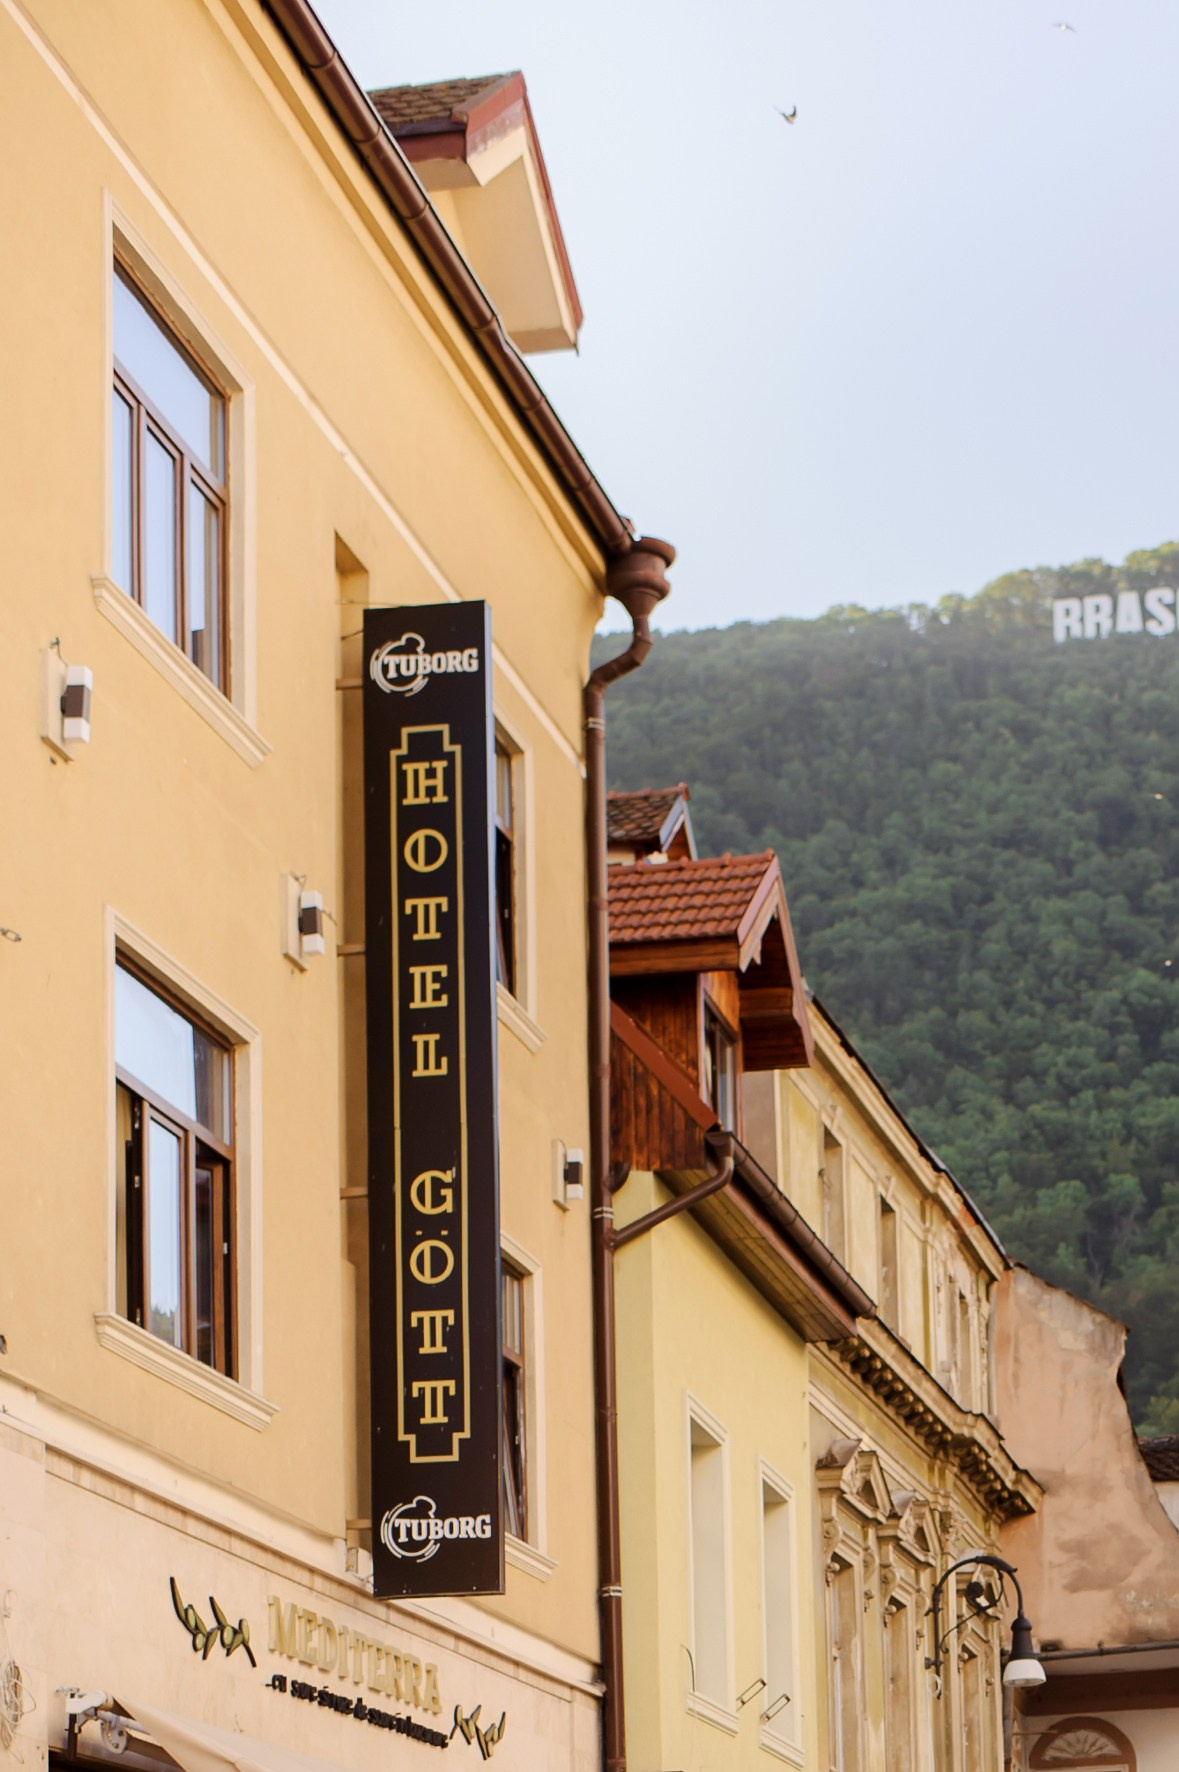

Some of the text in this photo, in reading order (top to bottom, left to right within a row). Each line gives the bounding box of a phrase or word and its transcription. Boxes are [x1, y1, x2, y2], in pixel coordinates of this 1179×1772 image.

[383, 648, 479, 679] TUBORG
[402, 760, 456, 1425] HOTEL GÖTT
[394, 1514, 491, 1543] TUBORG
[267, 1595, 442, 1715] MEDITERRA
